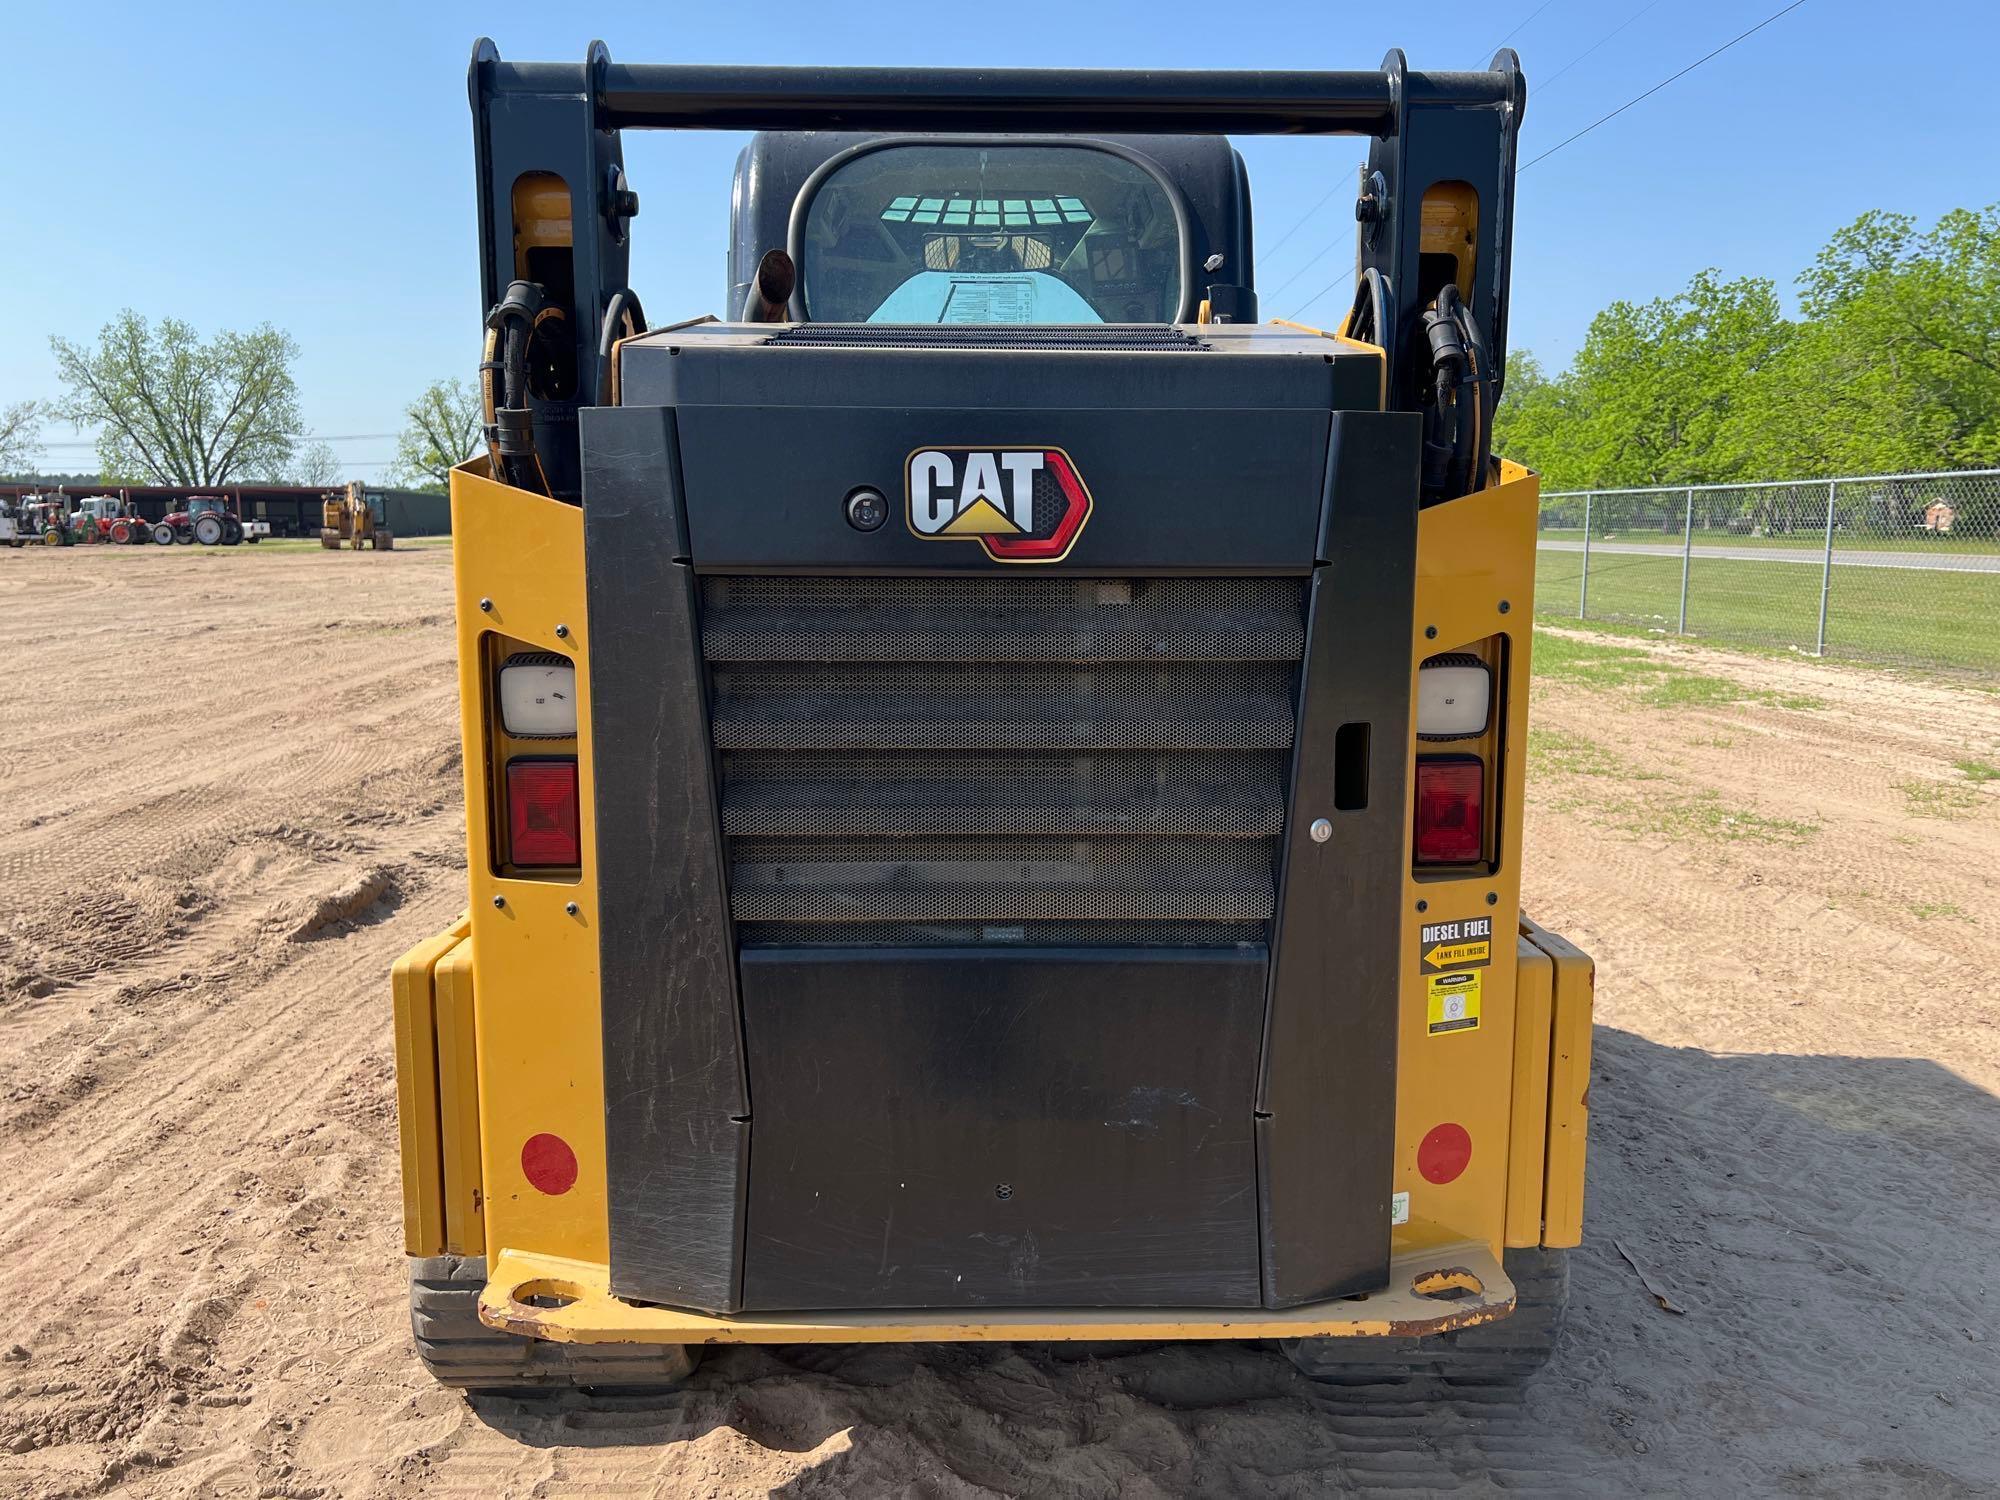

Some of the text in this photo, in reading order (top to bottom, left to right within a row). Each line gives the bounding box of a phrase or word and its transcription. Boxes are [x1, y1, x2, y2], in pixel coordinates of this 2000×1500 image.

[911, 451, 1044, 533] CAT
[1422, 920, 1490, 943] DIESEL FUEL
[1437, 946, 1486, 960] TANK FILL INSIDE
[1443, 976, 1467, 984] WARNING
